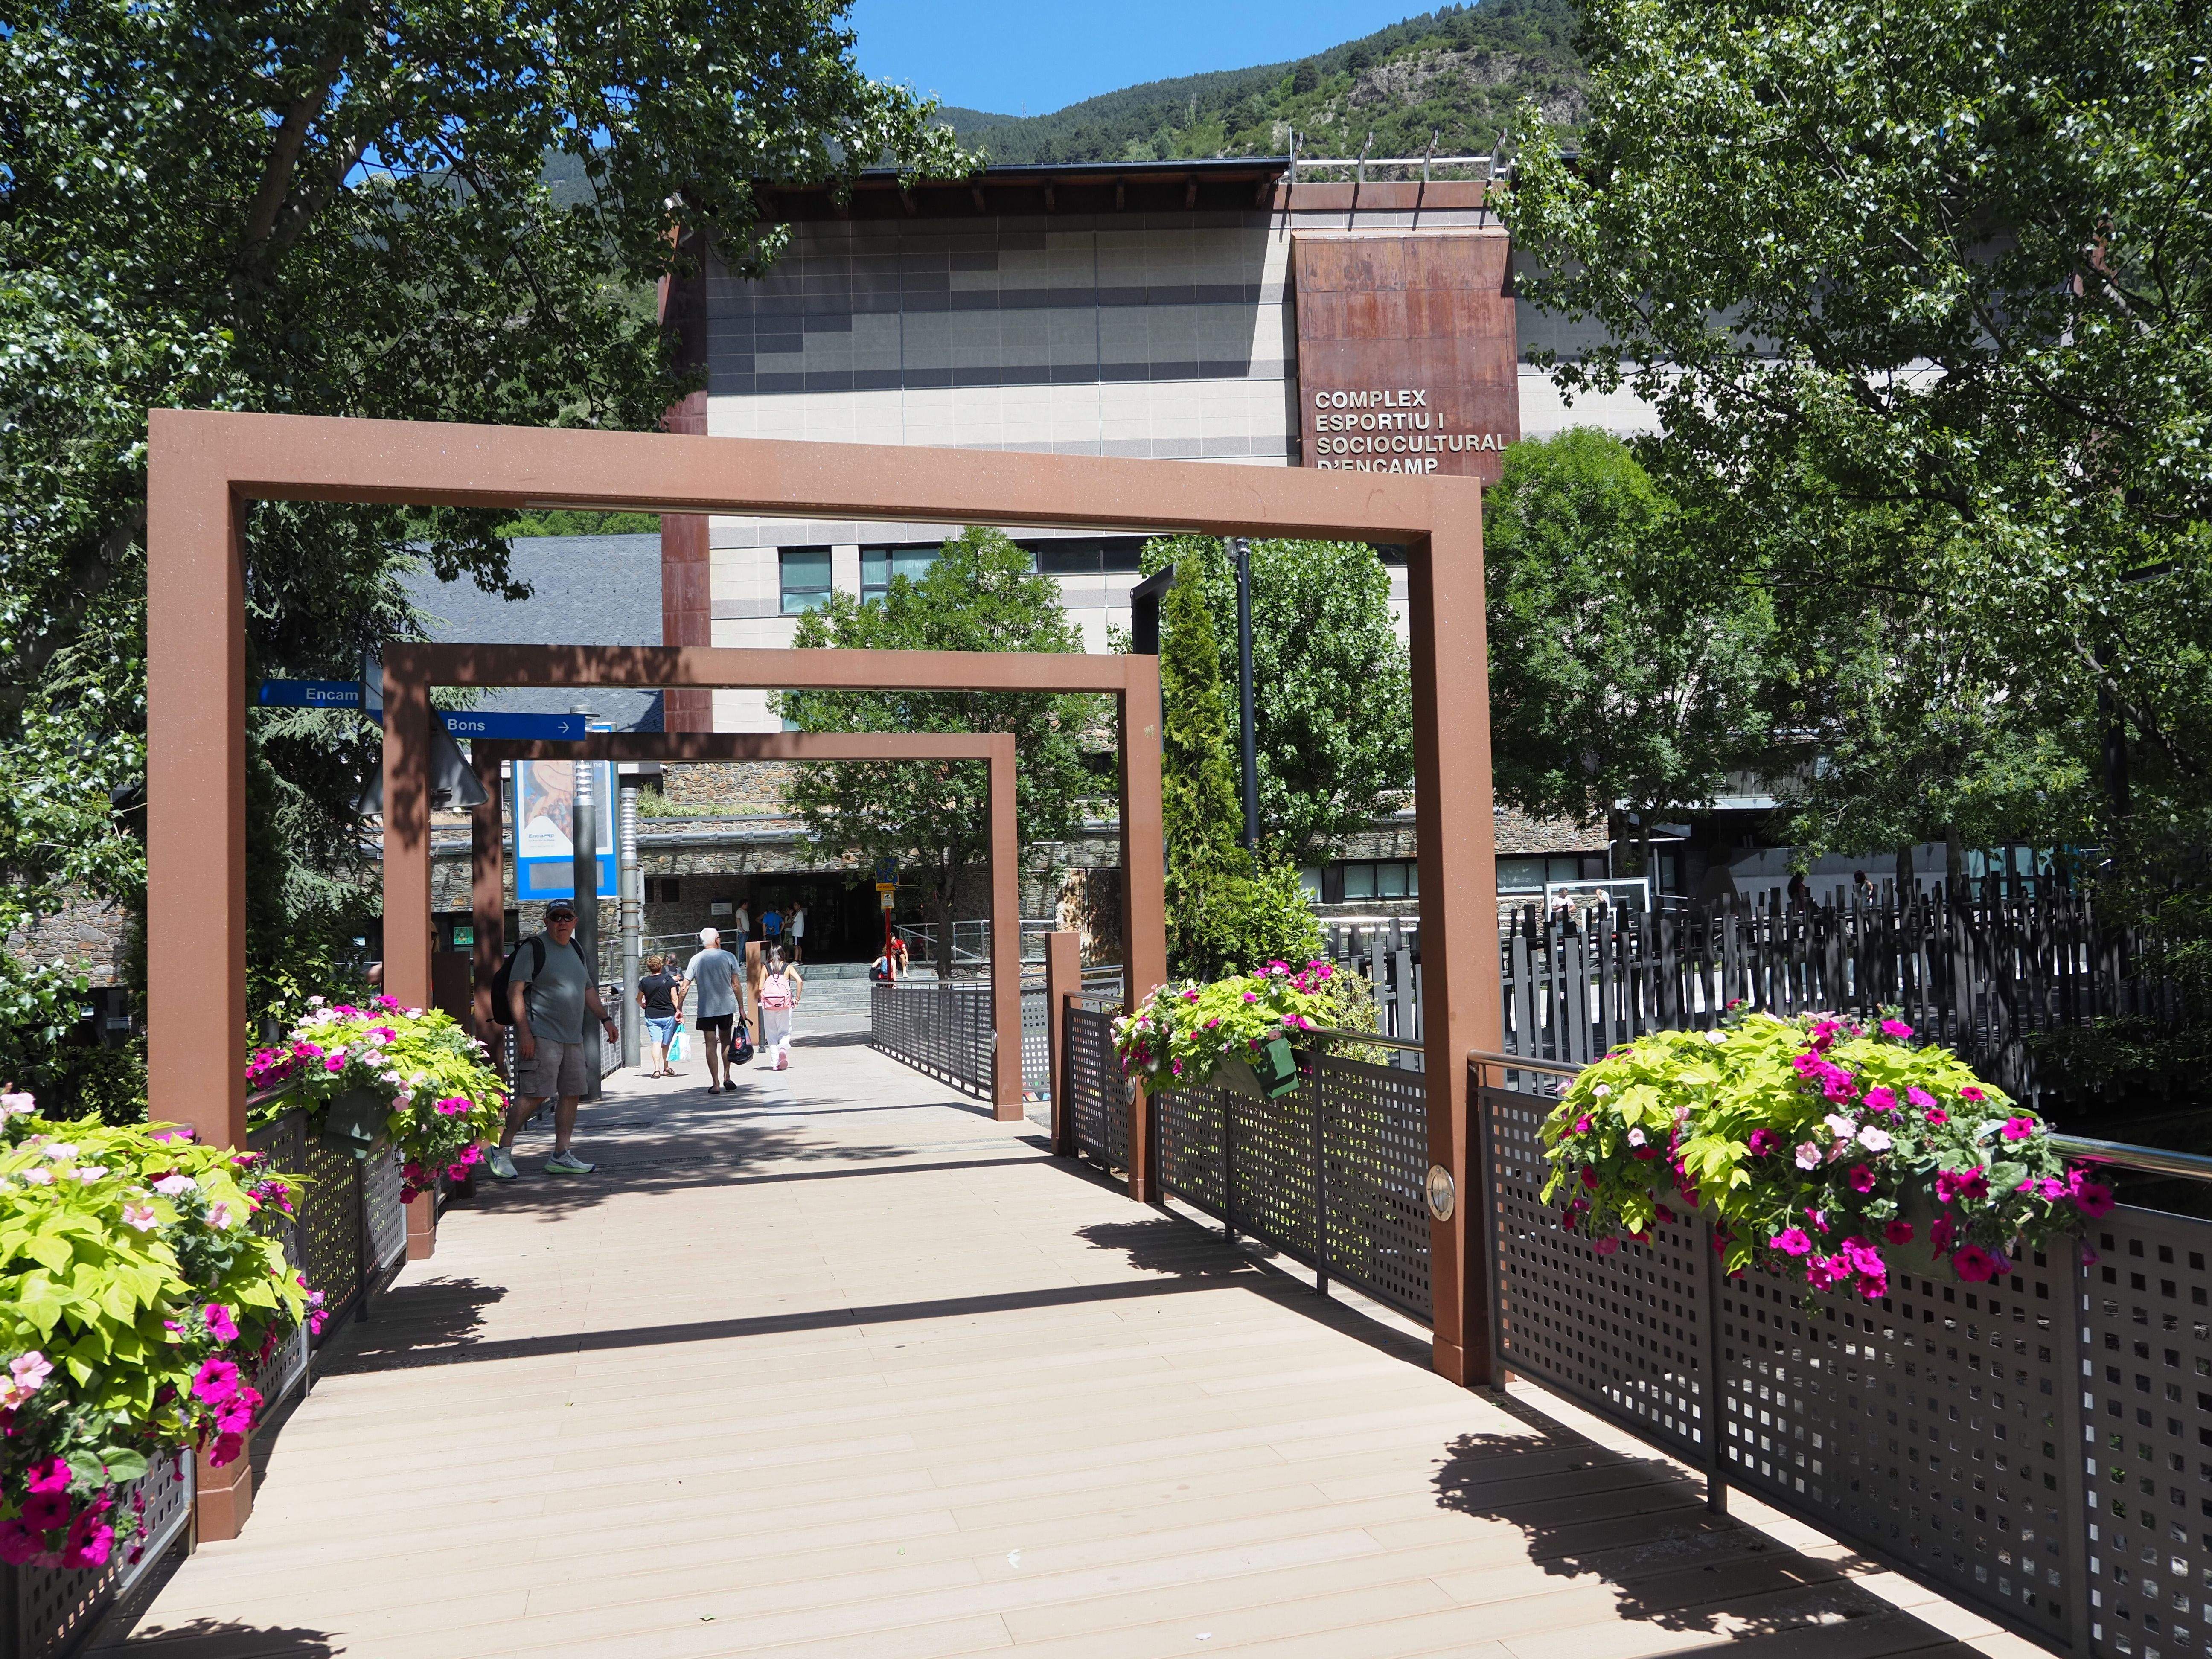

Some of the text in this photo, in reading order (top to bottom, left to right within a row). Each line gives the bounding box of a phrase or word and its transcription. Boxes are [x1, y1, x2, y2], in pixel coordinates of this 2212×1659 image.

[1315, 389, 1427, 408] COMPLEX
[1316, 413, 1444, 431] ESPORTIU I
[1317, 434, 1508, 454] SOCIOCULTURAL
[306, 688, 358, 701] Encam
[448, 719, 486, 731] Bons
